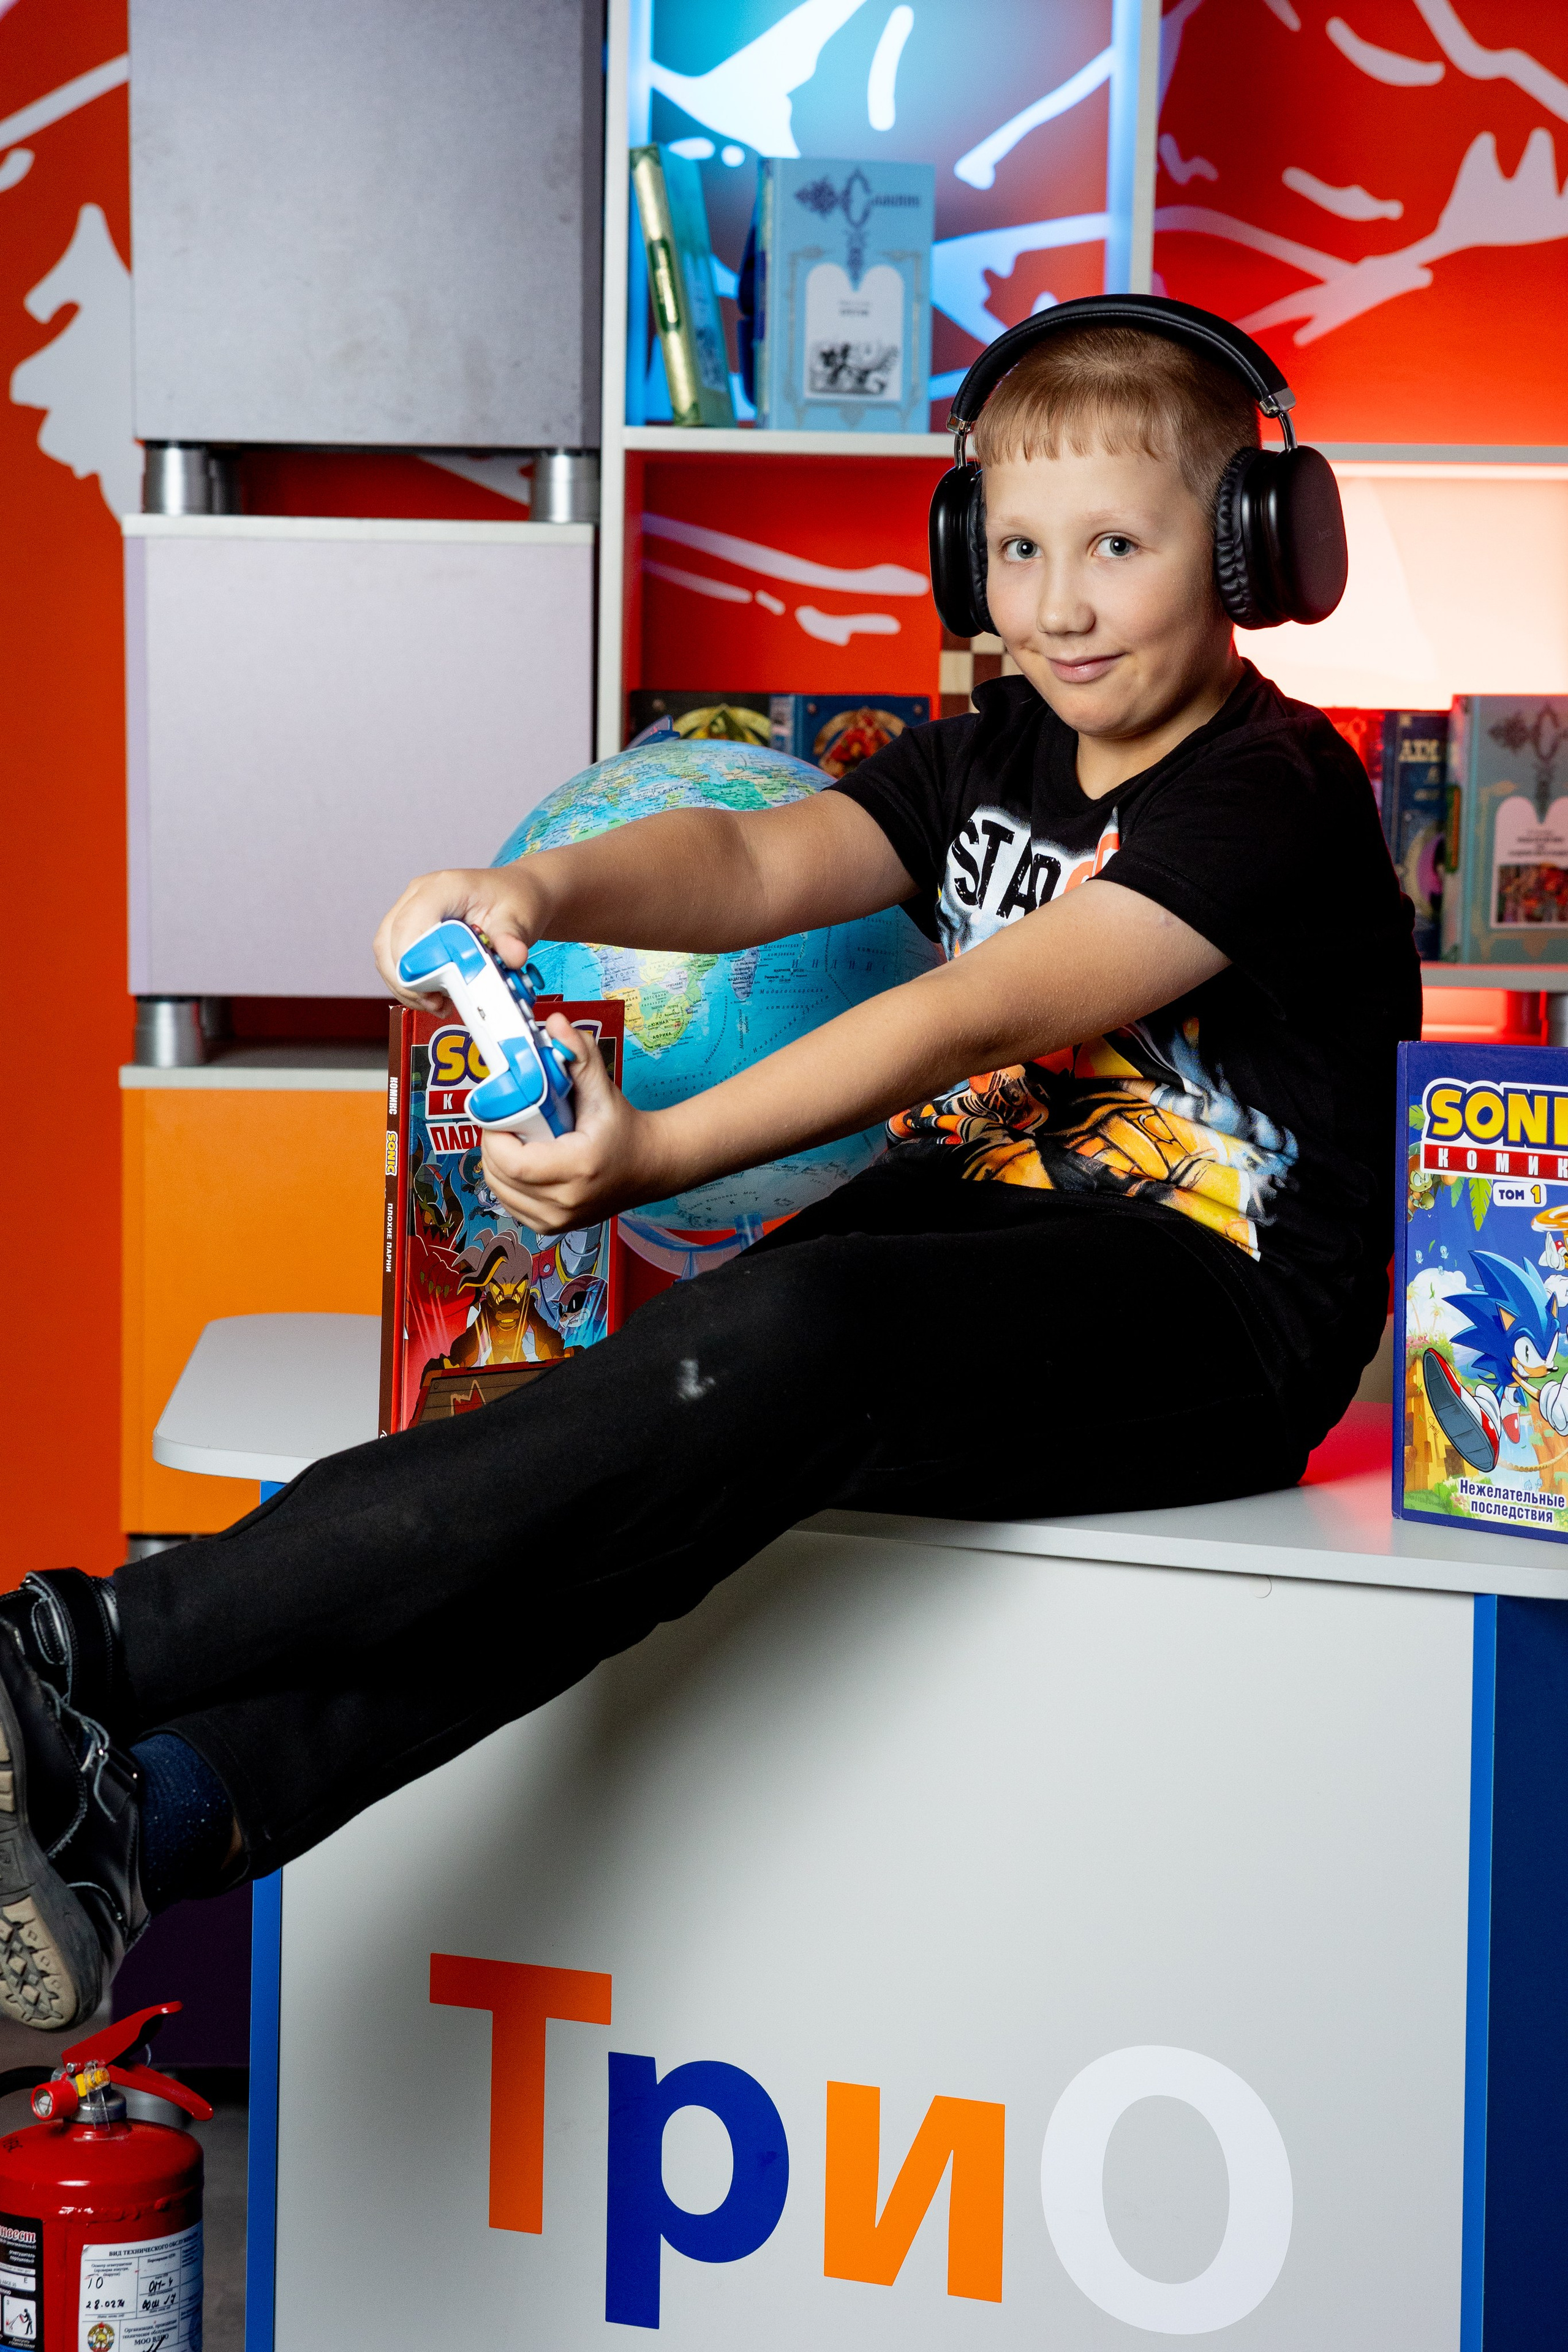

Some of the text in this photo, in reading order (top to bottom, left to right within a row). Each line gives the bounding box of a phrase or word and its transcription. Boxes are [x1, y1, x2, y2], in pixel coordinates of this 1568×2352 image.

[389, 1076, 398, 1116] КОМИКС
[429, 1125, 483, 1151] ПЛОХ
[386, 1132, 398, 1175] SONIC
[1530, 1184, 1542, 1205] 1
[1460, 1479, 1566, 1509] Нежелательные
[1471, 1500, 1554, 1524] последствия
[123, 2243, 168, 2256] ТЕХНИЧЕСКОГО
